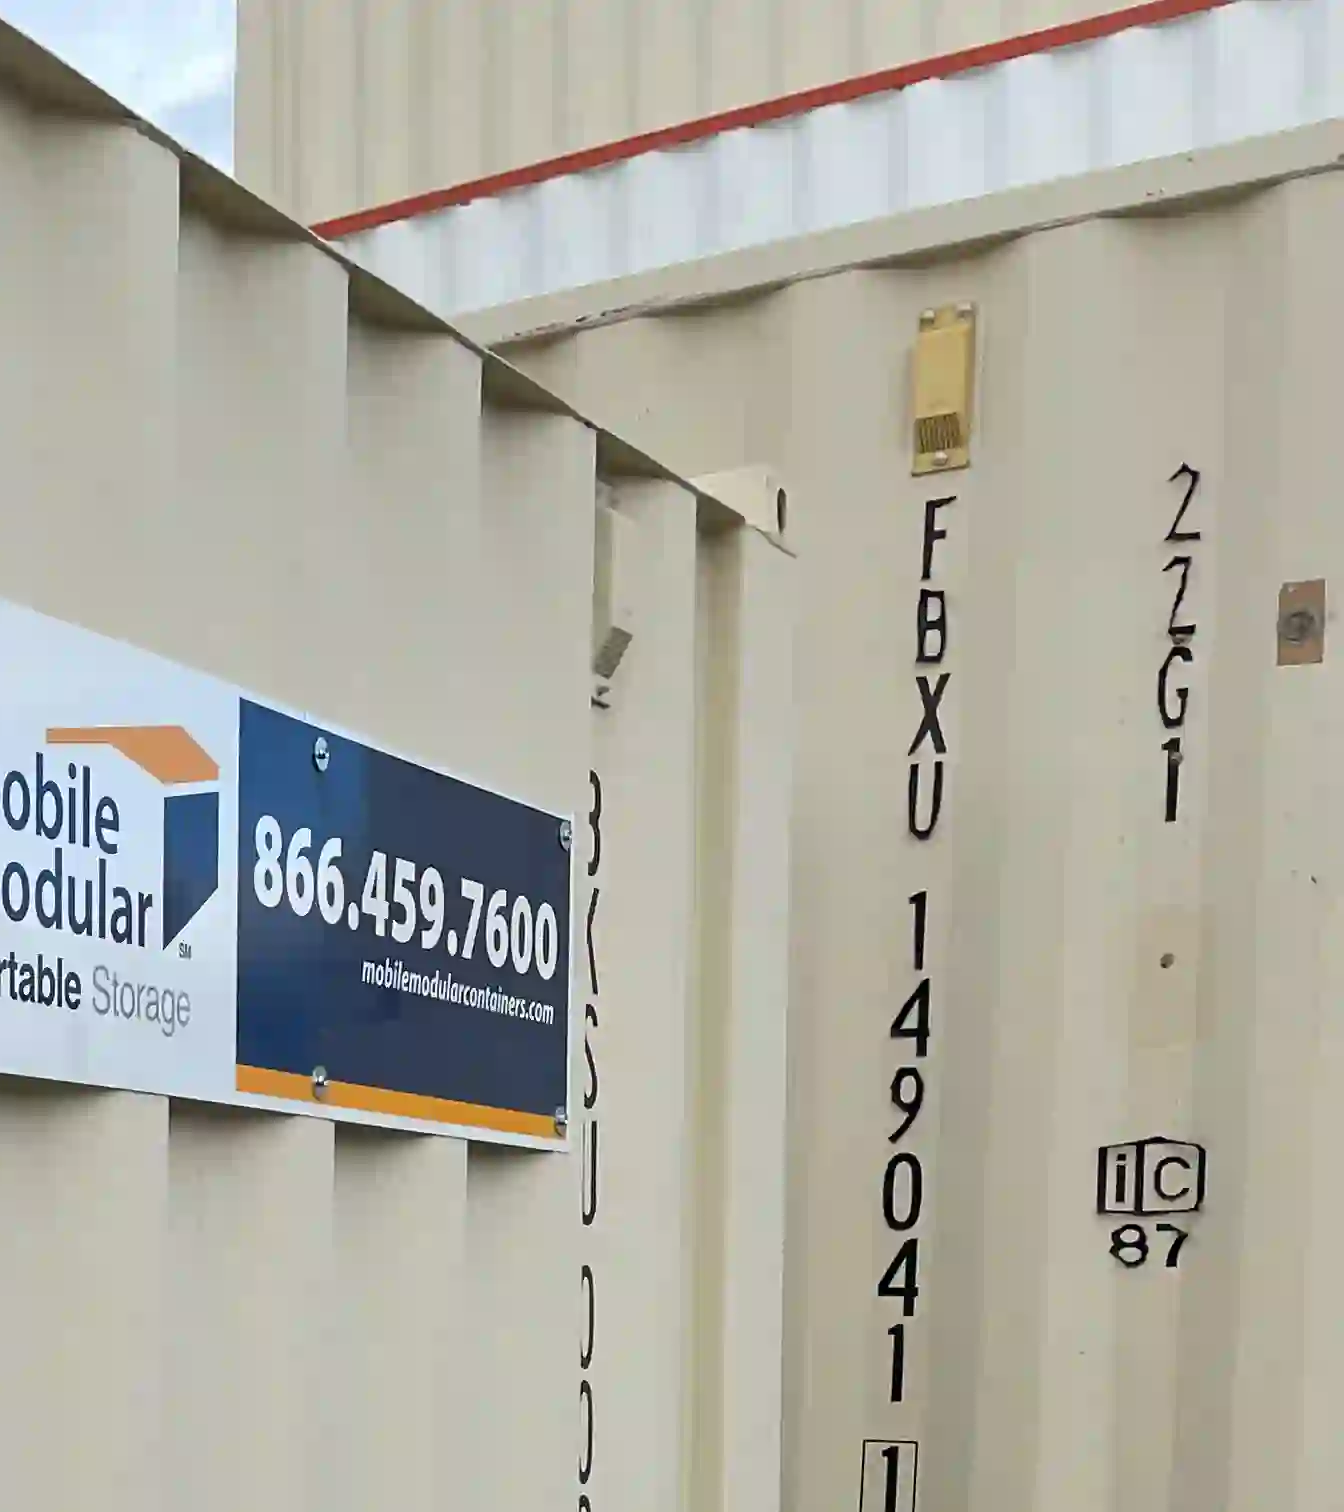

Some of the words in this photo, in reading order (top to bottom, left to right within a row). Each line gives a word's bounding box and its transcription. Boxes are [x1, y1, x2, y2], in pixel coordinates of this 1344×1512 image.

[907, 495, 957, 841] FBXU
[1157, 462, 1202, 823] 22G1
[253, 814, 559, 981] 866.459.7600
[92, 964, 192, 1038] Storage
[361, 957, 555, 1025] mobilemodularcontainers.com
[877, 890, 930, 1403] 149041
[1108, 1223, 1189, 1269] 87
